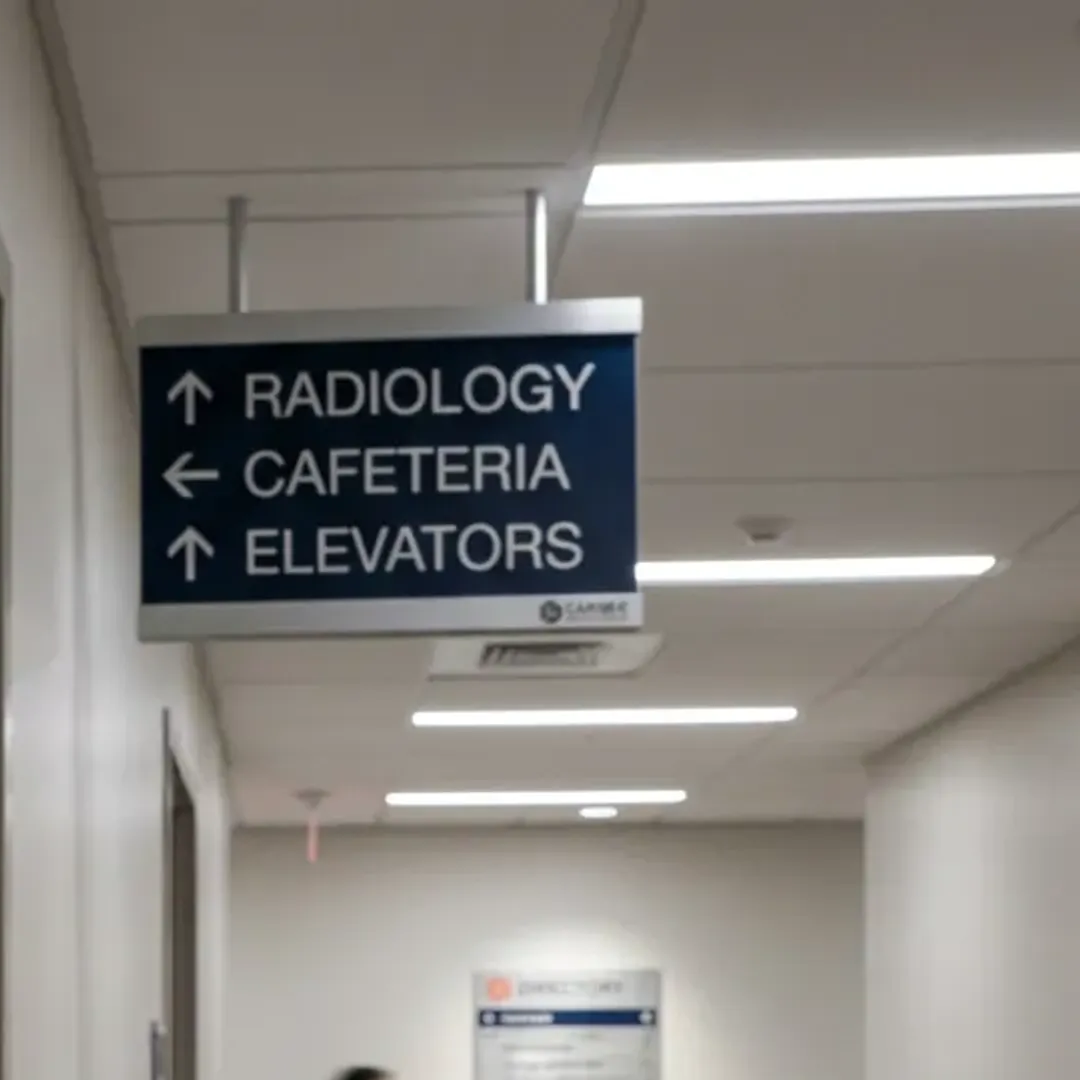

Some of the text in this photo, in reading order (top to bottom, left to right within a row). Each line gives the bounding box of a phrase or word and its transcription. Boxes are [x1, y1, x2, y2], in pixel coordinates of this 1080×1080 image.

[245, 362, 596, 418] RADIOLOGY
[244, 443, 571, 498] CAFETERIA
[246, 521, 584, 575] ELEVATORS
